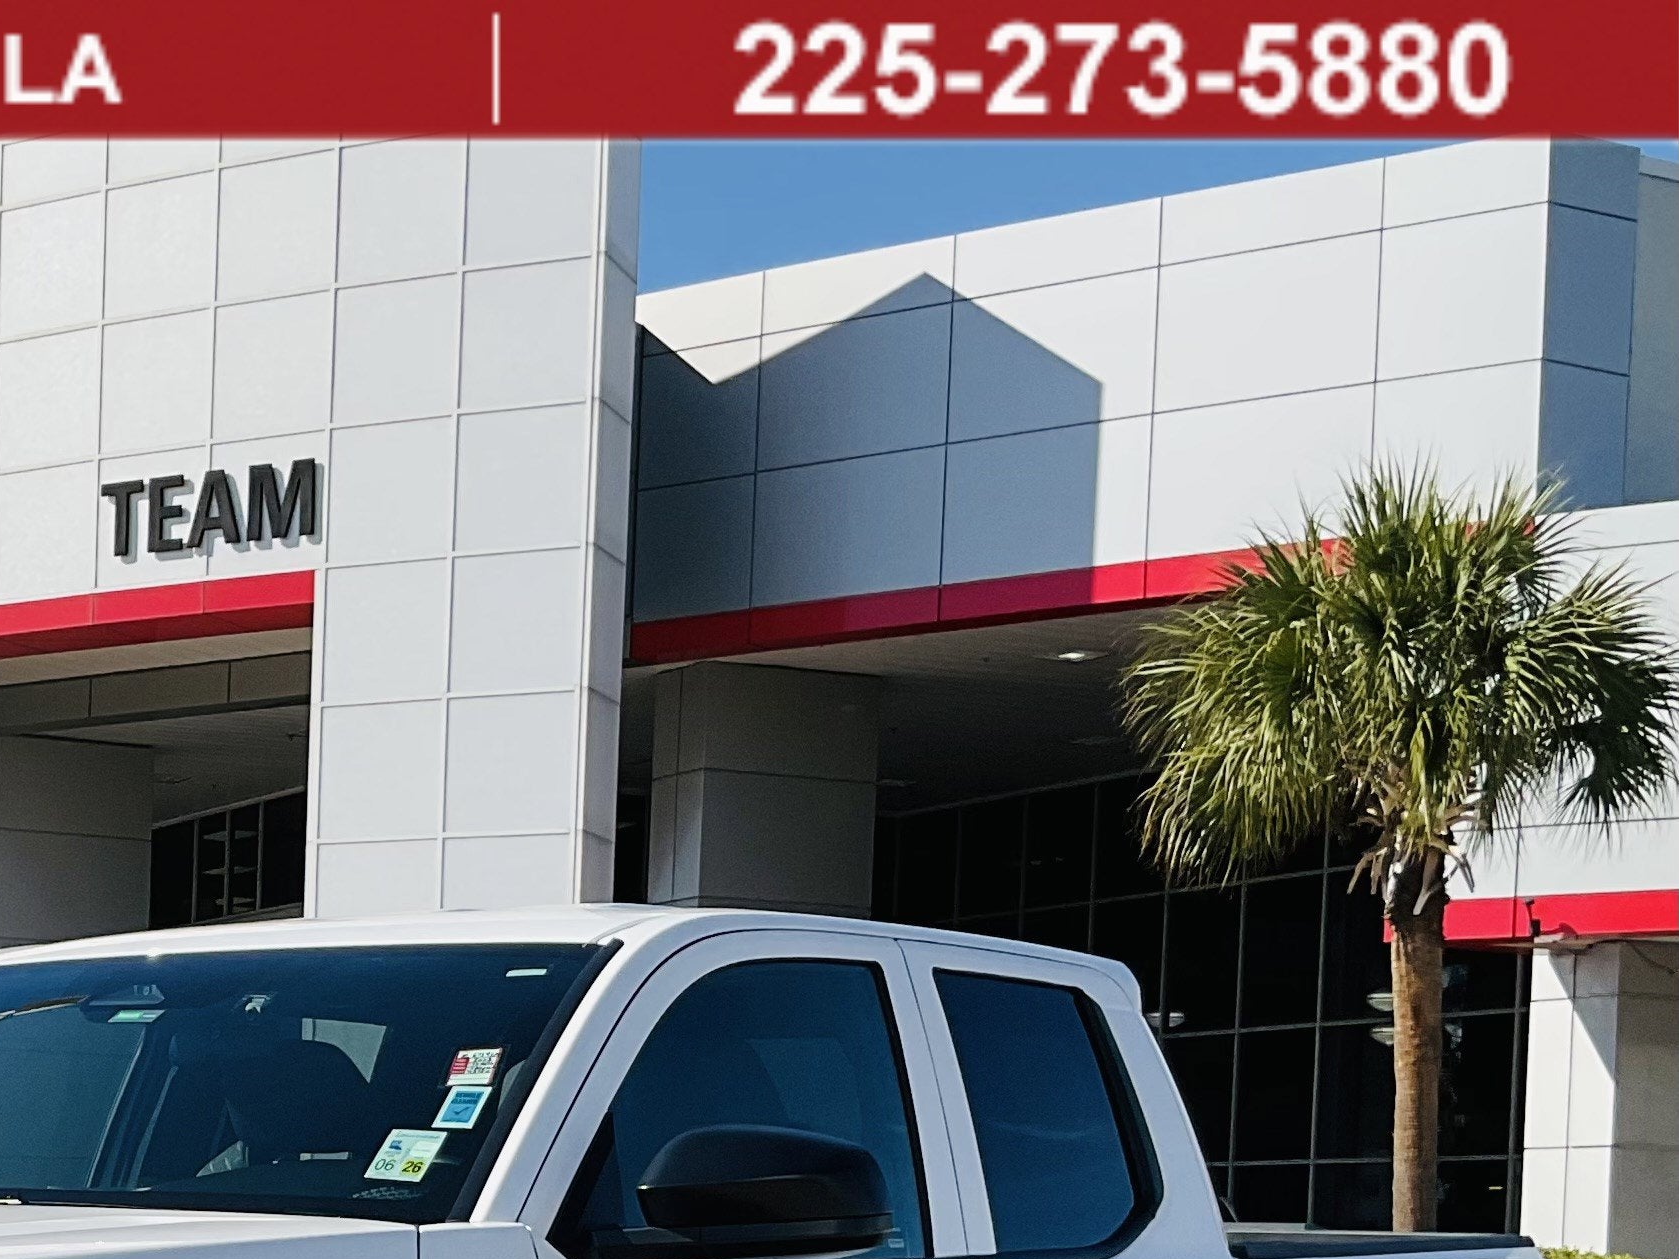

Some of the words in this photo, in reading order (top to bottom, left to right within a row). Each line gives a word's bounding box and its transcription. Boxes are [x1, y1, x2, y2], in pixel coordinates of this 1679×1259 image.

[101, 456, 317, 558] TEAM
[374, 1158, 397, 1171] 06
[402, 1161, 426, 1173] 26
